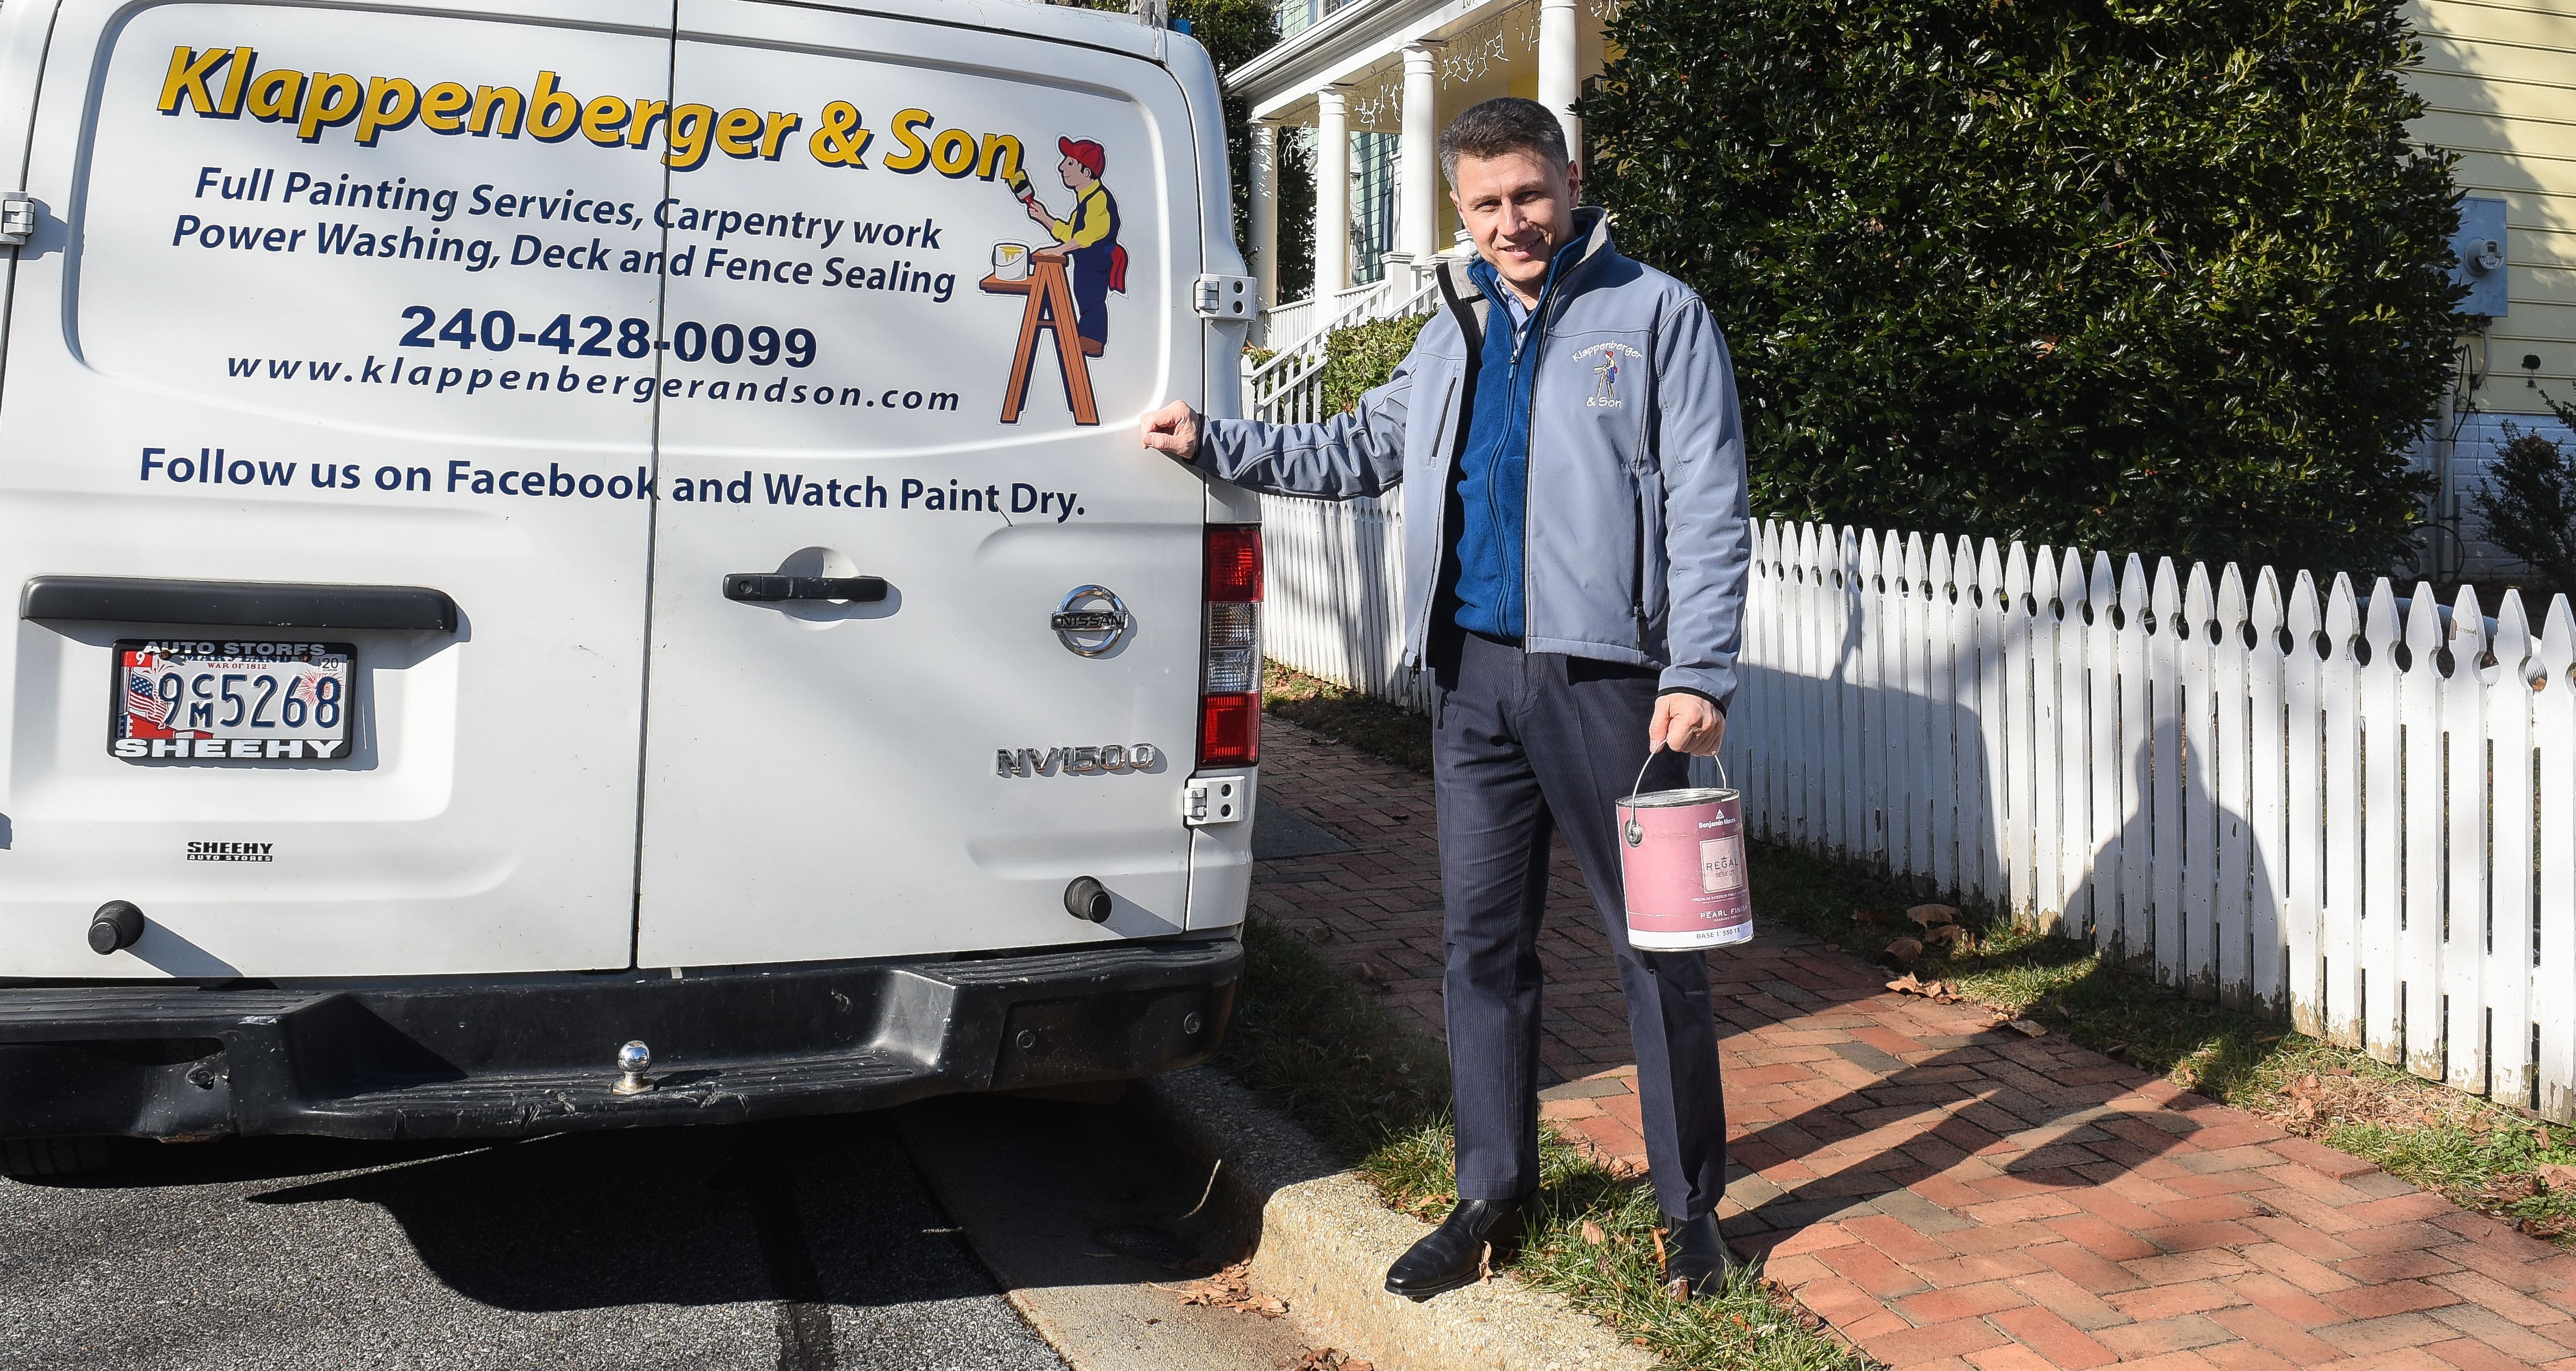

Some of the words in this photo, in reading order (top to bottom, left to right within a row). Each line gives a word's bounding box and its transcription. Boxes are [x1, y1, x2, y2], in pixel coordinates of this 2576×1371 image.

[156, 45, 802, 172] Klappenberger
[809, 100, 874, 170] &
[883, 108, 1026, 183] Son
[194, 166, 275, 203] Full
[282, 171, 458, 222] Painting
[468, 183, 643, 231] Services,
[653, 197, 845, 250] Carpentry
[853, 217, 944, 249] work
[171, 214, 306, 254] Power
[317, 222, 500, 273] Washing,
[509, 233, 613, 273] Deck
[618, 245, 696, 277] and
[704, 246, 814, 284] Fence
[821, 254, 957, 304] Sealing
[398, 305, 818, 369] 240-428-0099
[1571, 339, 1643, 363] Klappenberger
[226, 356, 960, 412] www.klappenbergerandson.com
[1586, 396, 1596, 407] &
[1598, 396, 1622, 408] Son
[140, 447, 298, 488] Follow
[309, 463, 362, 490] us
[374, 465, 432, 492] on
[446, 459, 661, 501] Facebook
[672, 470, 753, 506] and
[763, 472, 887, 509] Watch
[900, 478, 1000, 514] Paint
[1009, 482, 1086, 525] Dry.
[1060, 615, 1122, 627] NISSAN
[143, 641, 216, 654] AUTO
[135, 651, 146, 665] 9
[322, 657, 339, 669] 20
[115, 738, 344, 759] SHEEHY
[996, 743, 1157, 775] NV1500
[1698, 819, 1723, 829] Benjamin
[187, 842, 273, 854] SHEEHY
[1706, 858, 1739, 871] REGAL
[1715, 869, 1735, 878] SELECT
[1700, 910, 1728, 919] PEARL
